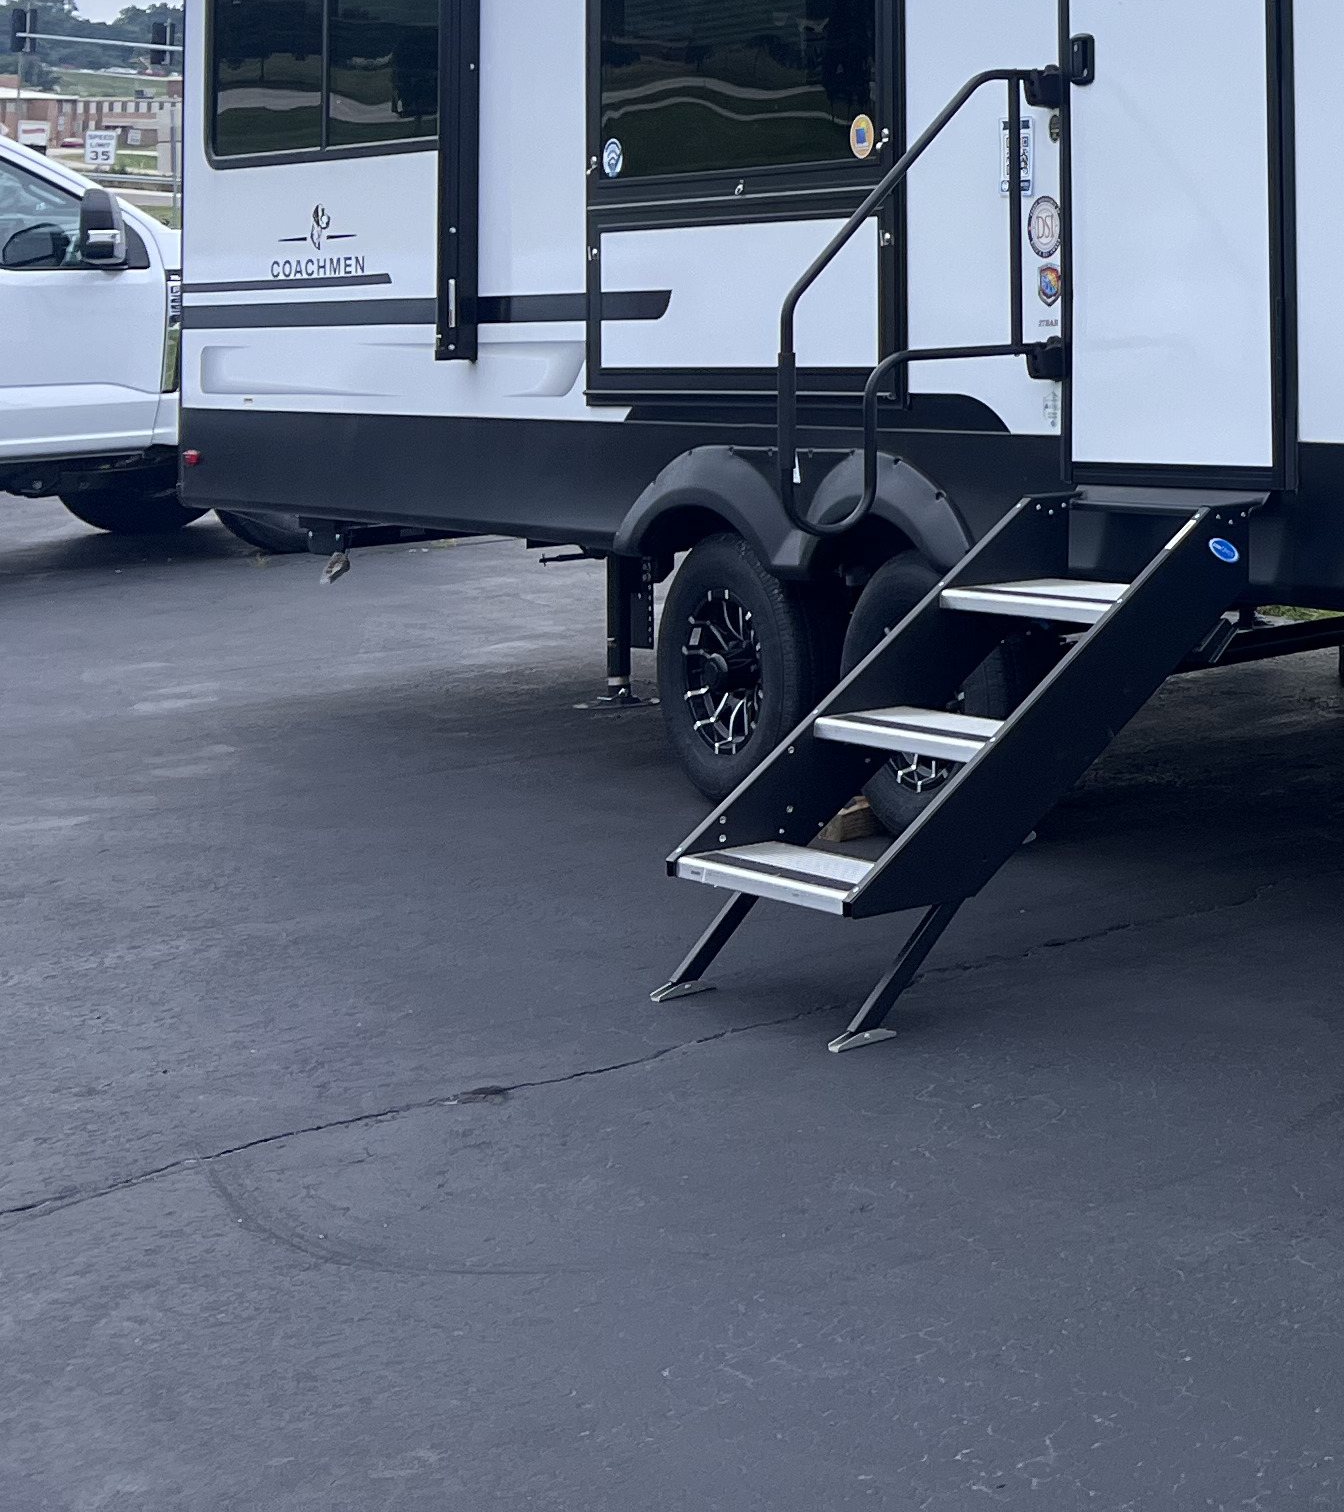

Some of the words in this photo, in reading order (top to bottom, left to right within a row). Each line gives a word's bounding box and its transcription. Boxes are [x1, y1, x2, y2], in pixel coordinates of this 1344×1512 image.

[90, 150, 110, 161] 35
[1036, 213, 1054, 239] DSI
[270, 255, 366, 278] COACHMEN
